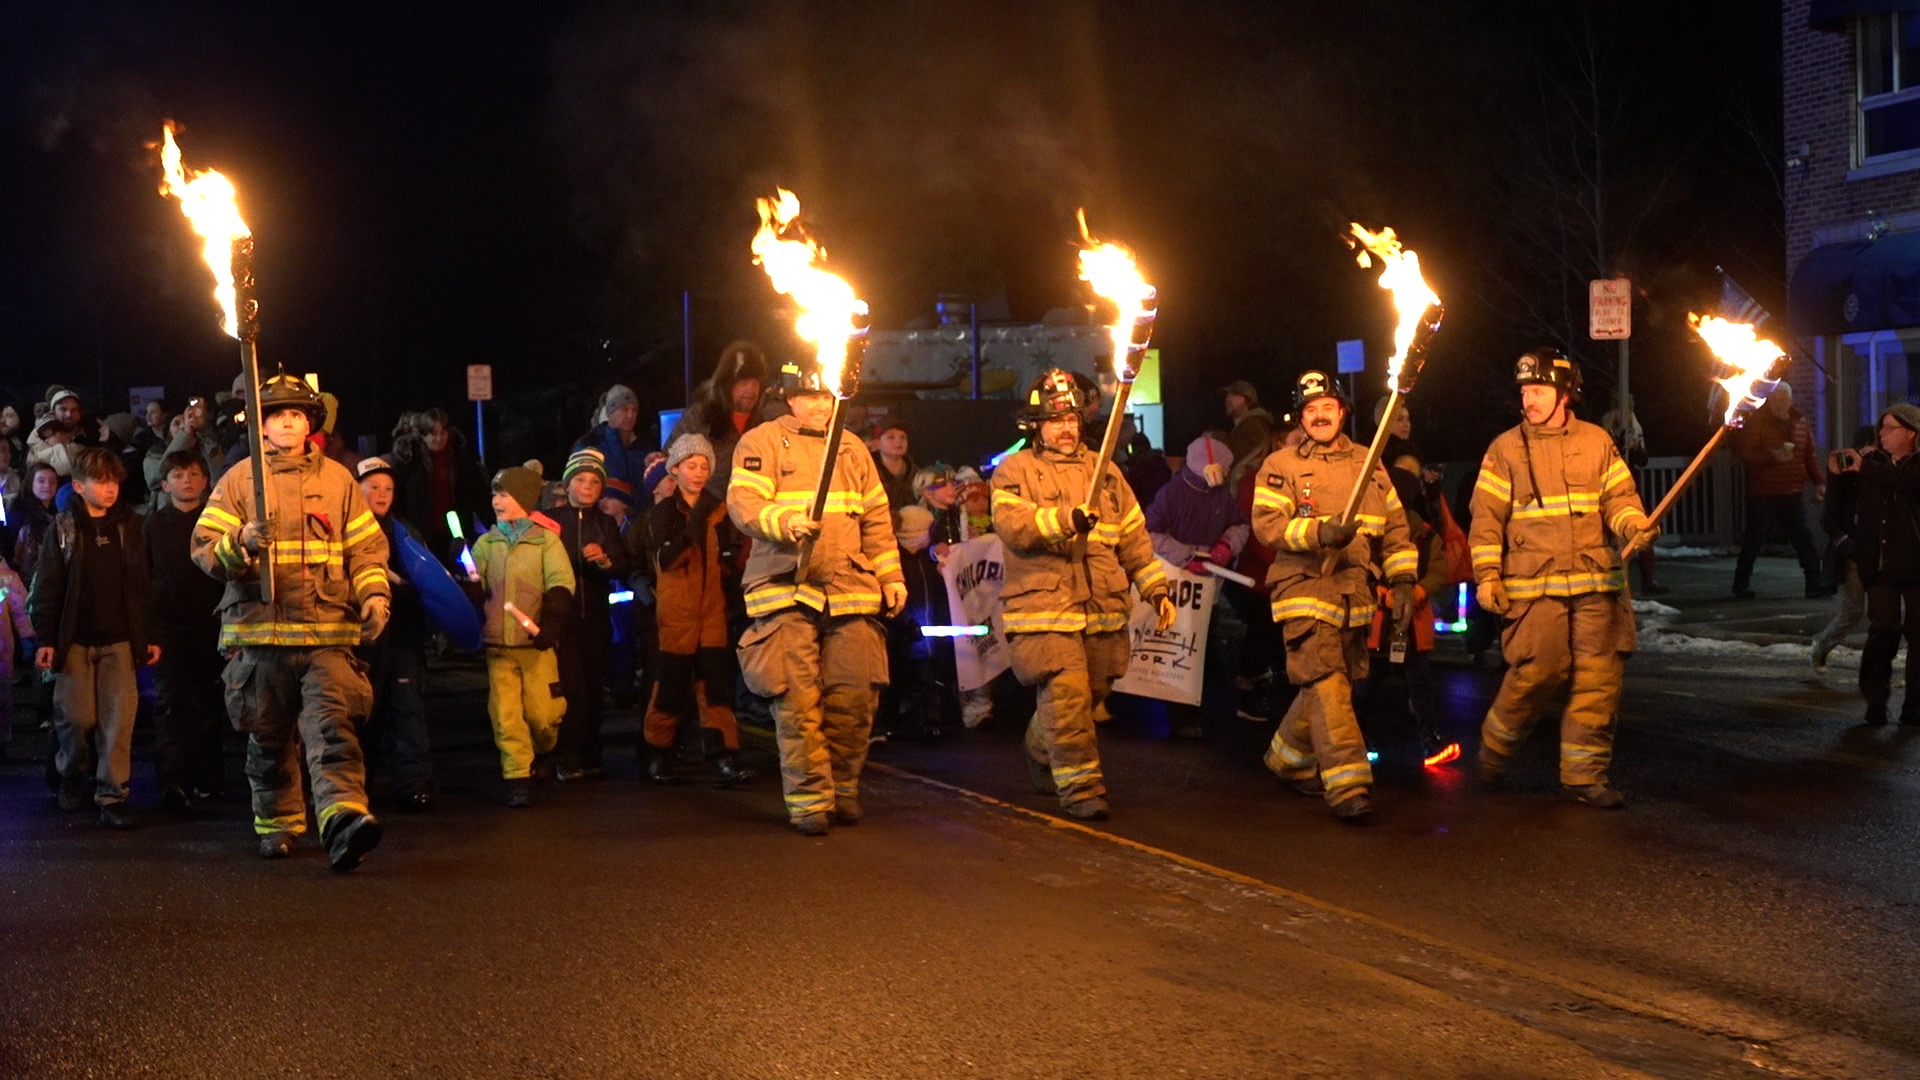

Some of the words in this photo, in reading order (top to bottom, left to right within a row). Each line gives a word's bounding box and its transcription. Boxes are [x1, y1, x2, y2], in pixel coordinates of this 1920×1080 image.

[1602, 282, 1617, 294] NO
[1593, 295, 1628, 307] PARKING
[1132, 622, 1197, 656] NORTH
